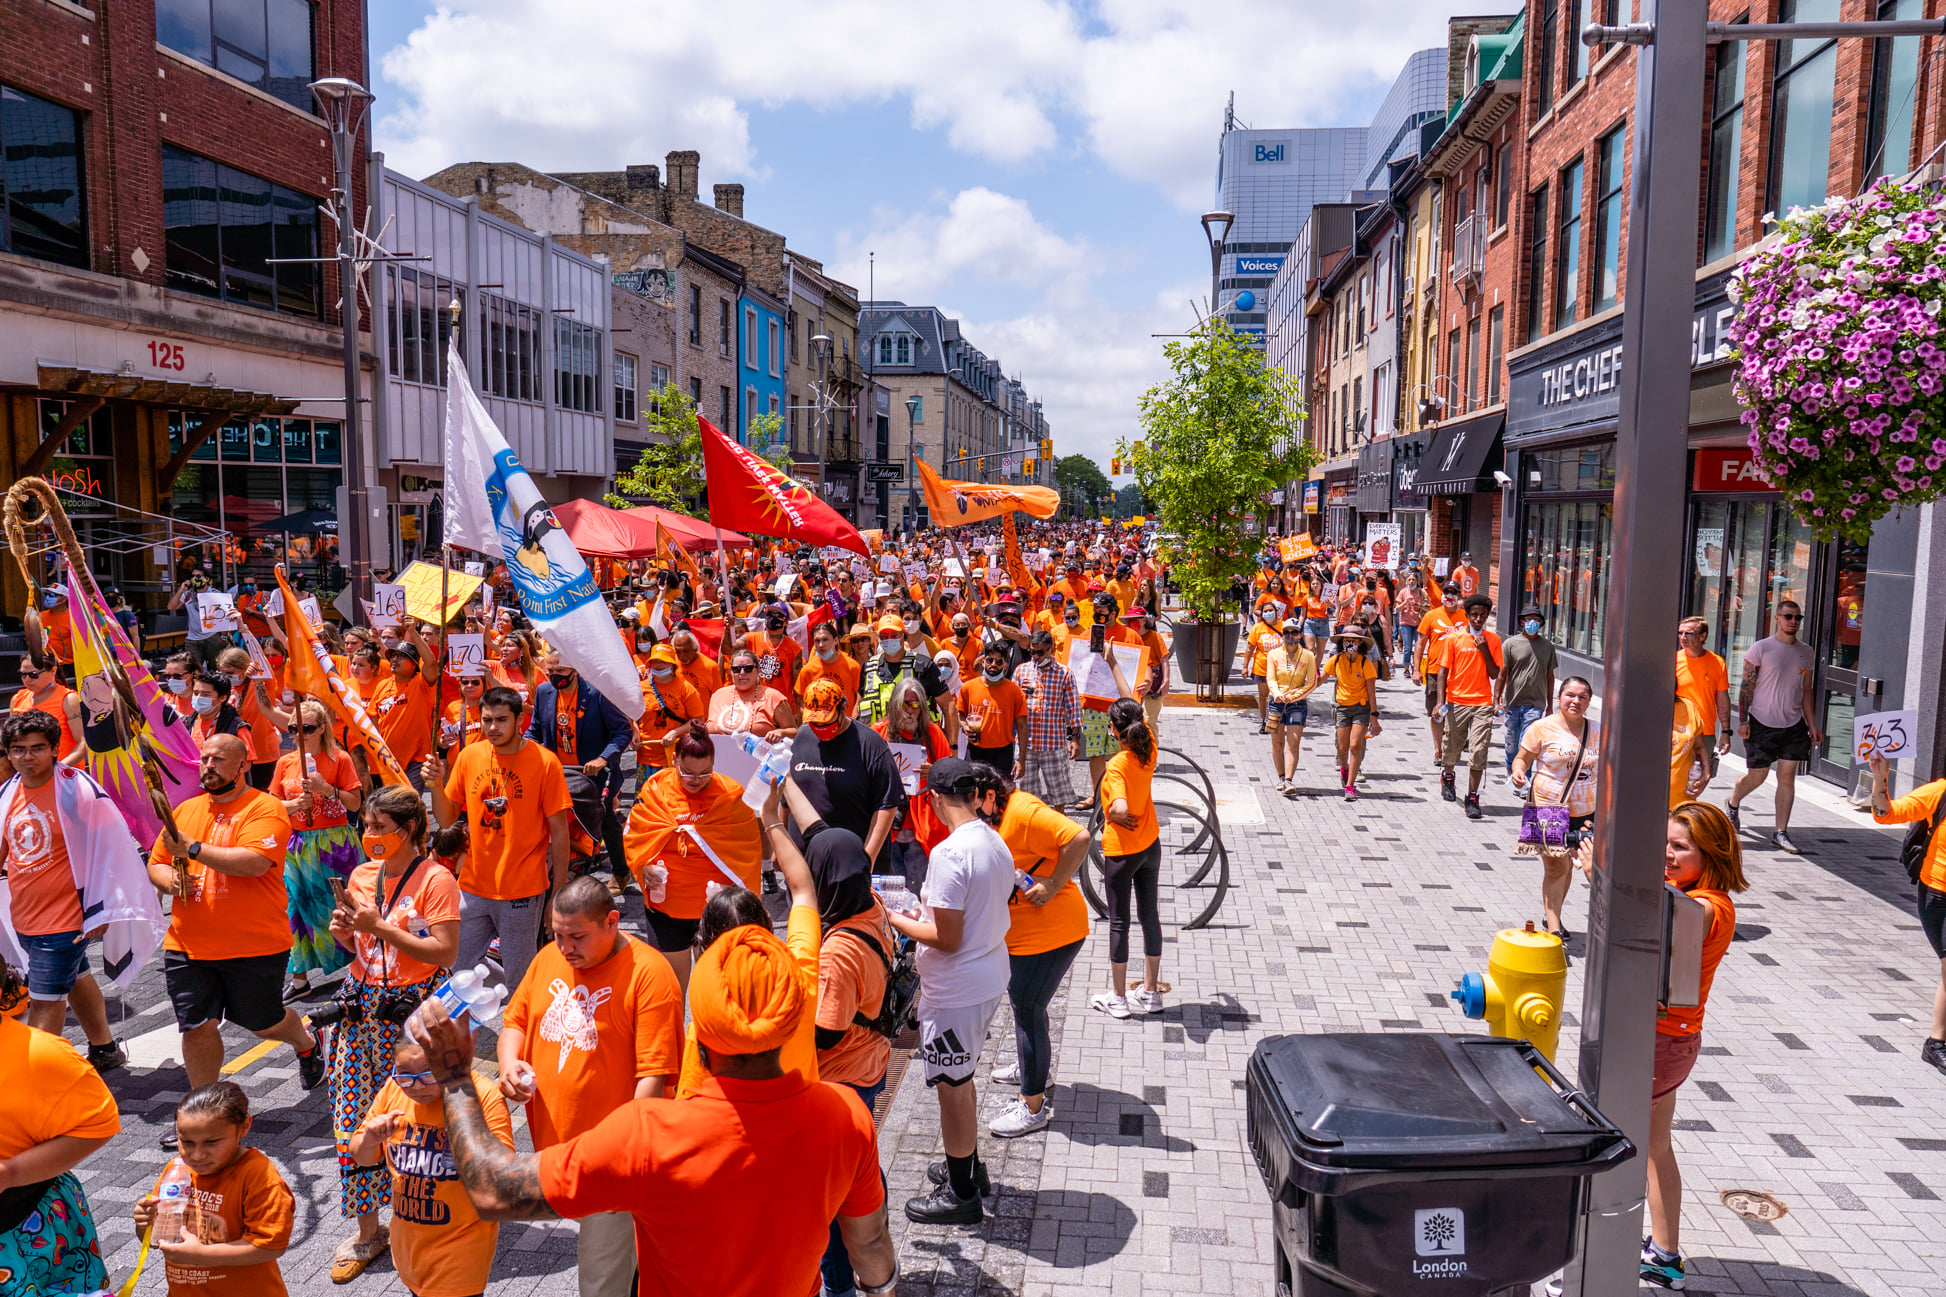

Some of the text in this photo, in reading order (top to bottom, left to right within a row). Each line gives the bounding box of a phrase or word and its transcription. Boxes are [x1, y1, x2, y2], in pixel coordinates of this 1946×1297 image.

[1255, 144, 1285, 162] Bell
[1240, 260, 1278, 271] Voices
[147, 341, 185, 371] 125
[1541, 363, 1573, 406] THE
[375, 589, 406, 617] 169
[517, 588, 544, 614] Point
[544, 595, 568, 615] First
[448, 643, 482, 666] 170
[1862, 718, 1907, 757] 363
[794, 761, 846, 775] Champion
[400, 1120, 446, 1150] LET'S
[400, 1174, 433, 1199] THE
[1412, 1257, 1467, 1274] London
[1420, 1272, 1462, 1280] CANADA
